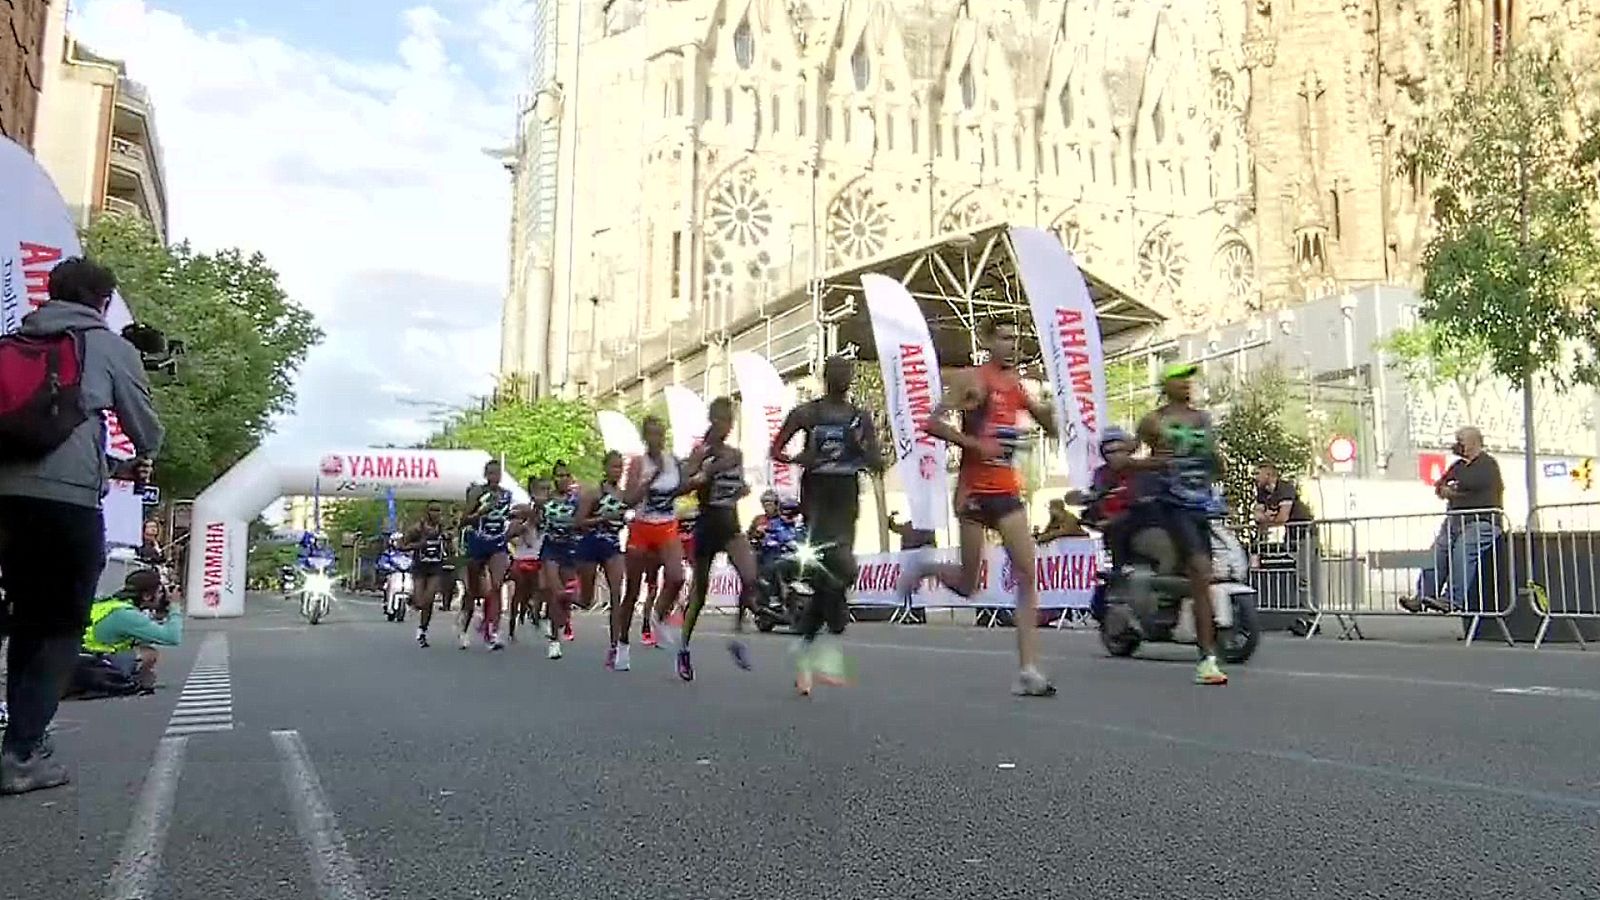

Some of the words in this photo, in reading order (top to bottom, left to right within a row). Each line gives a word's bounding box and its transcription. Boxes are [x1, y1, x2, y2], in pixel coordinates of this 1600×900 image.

[347, 455, 439, 478] YAMAHA
[203, 521, 225, 588] YAMAHA
[1036, 553, 1098, 591] AMAHA
